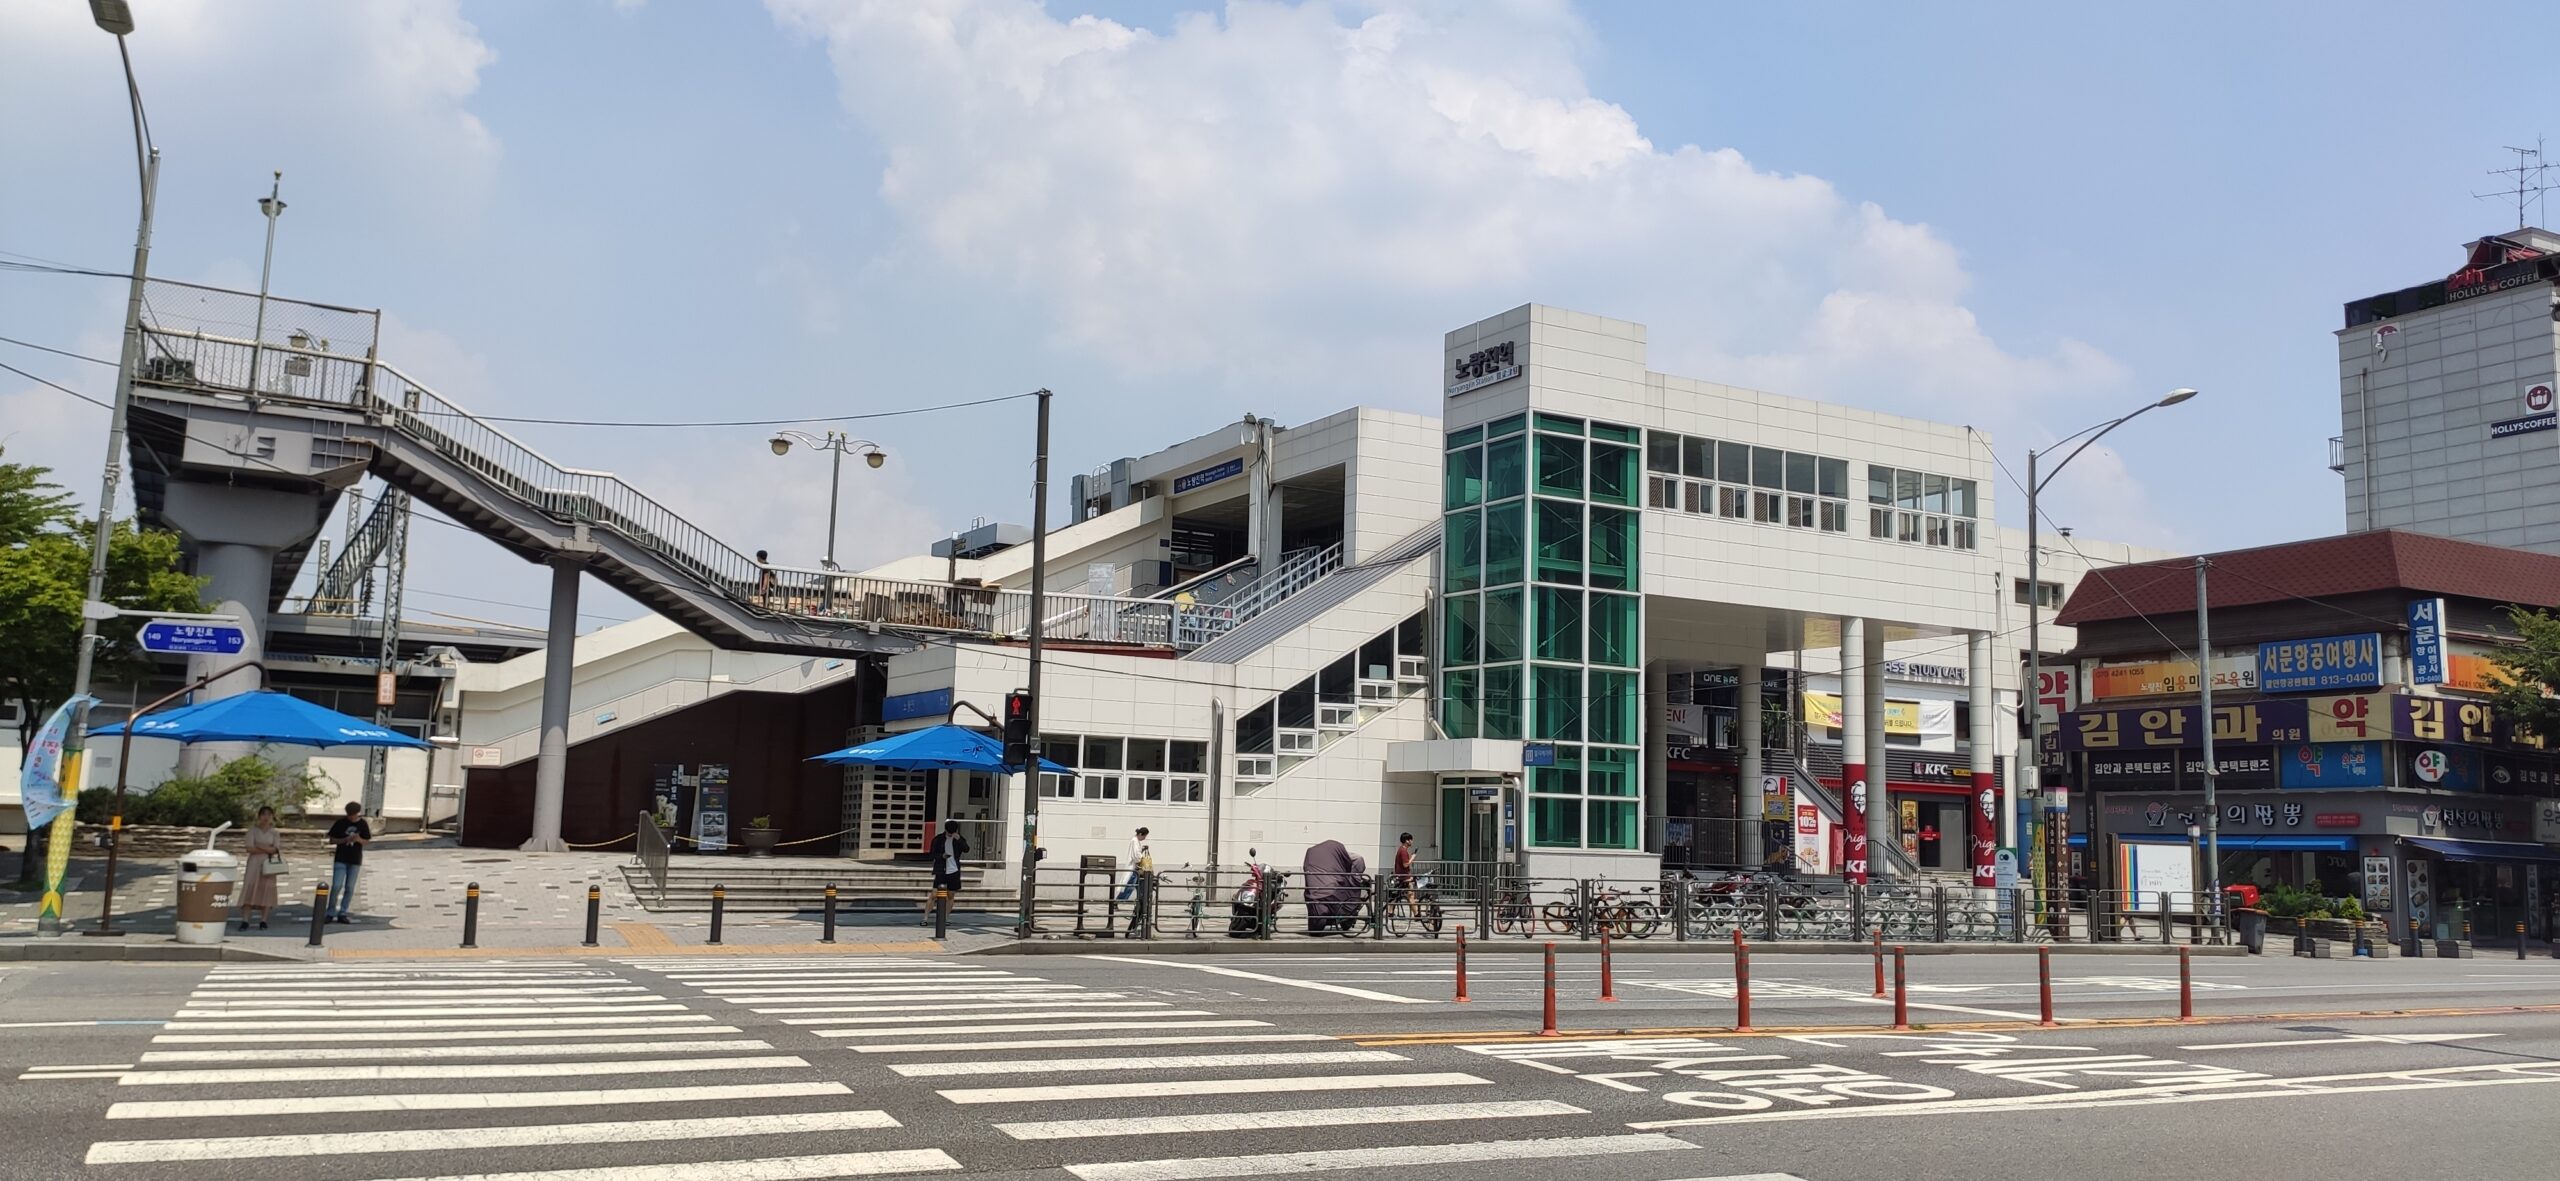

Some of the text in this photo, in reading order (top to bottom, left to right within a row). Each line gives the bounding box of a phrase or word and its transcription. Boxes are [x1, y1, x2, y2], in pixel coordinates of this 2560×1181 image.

[2449, 285, 2487, 301] HOLLYS
[1455, 340, 1514, 379] 노량진역
[2491, 416, 2557, 435] HOLLYSCOFFEE
[174, 627, 215, 637] 노량진로
[2413, 602, 2435, 645] 서문
[2264, 638, 2373, 674] 서문항공여행사
[2416, 646, 2426, 674] 항공
[2427, 645, 2438, 673] 여행사
[1703, 674, 1722, 683] ONE
[2163, 671, 2255, 692] 임용미교육원
[2321, 672, 2374, 685] 813-0400
[2078, 704, 2301, 747] 김안과 의원
[2333, 697, 2370, 737] 약
[2045, 735, 2056, 750] 김
[1925, 763, 1948, 776] KFC
[2039, 752, 2064, 767] 안과
[2094, 763, 2122, 775] 김안과
[2186, 761, 2208, 773] 김안
[2299, 745, 2323, 777] 약
[2419, 752, 2440, 779] 약
